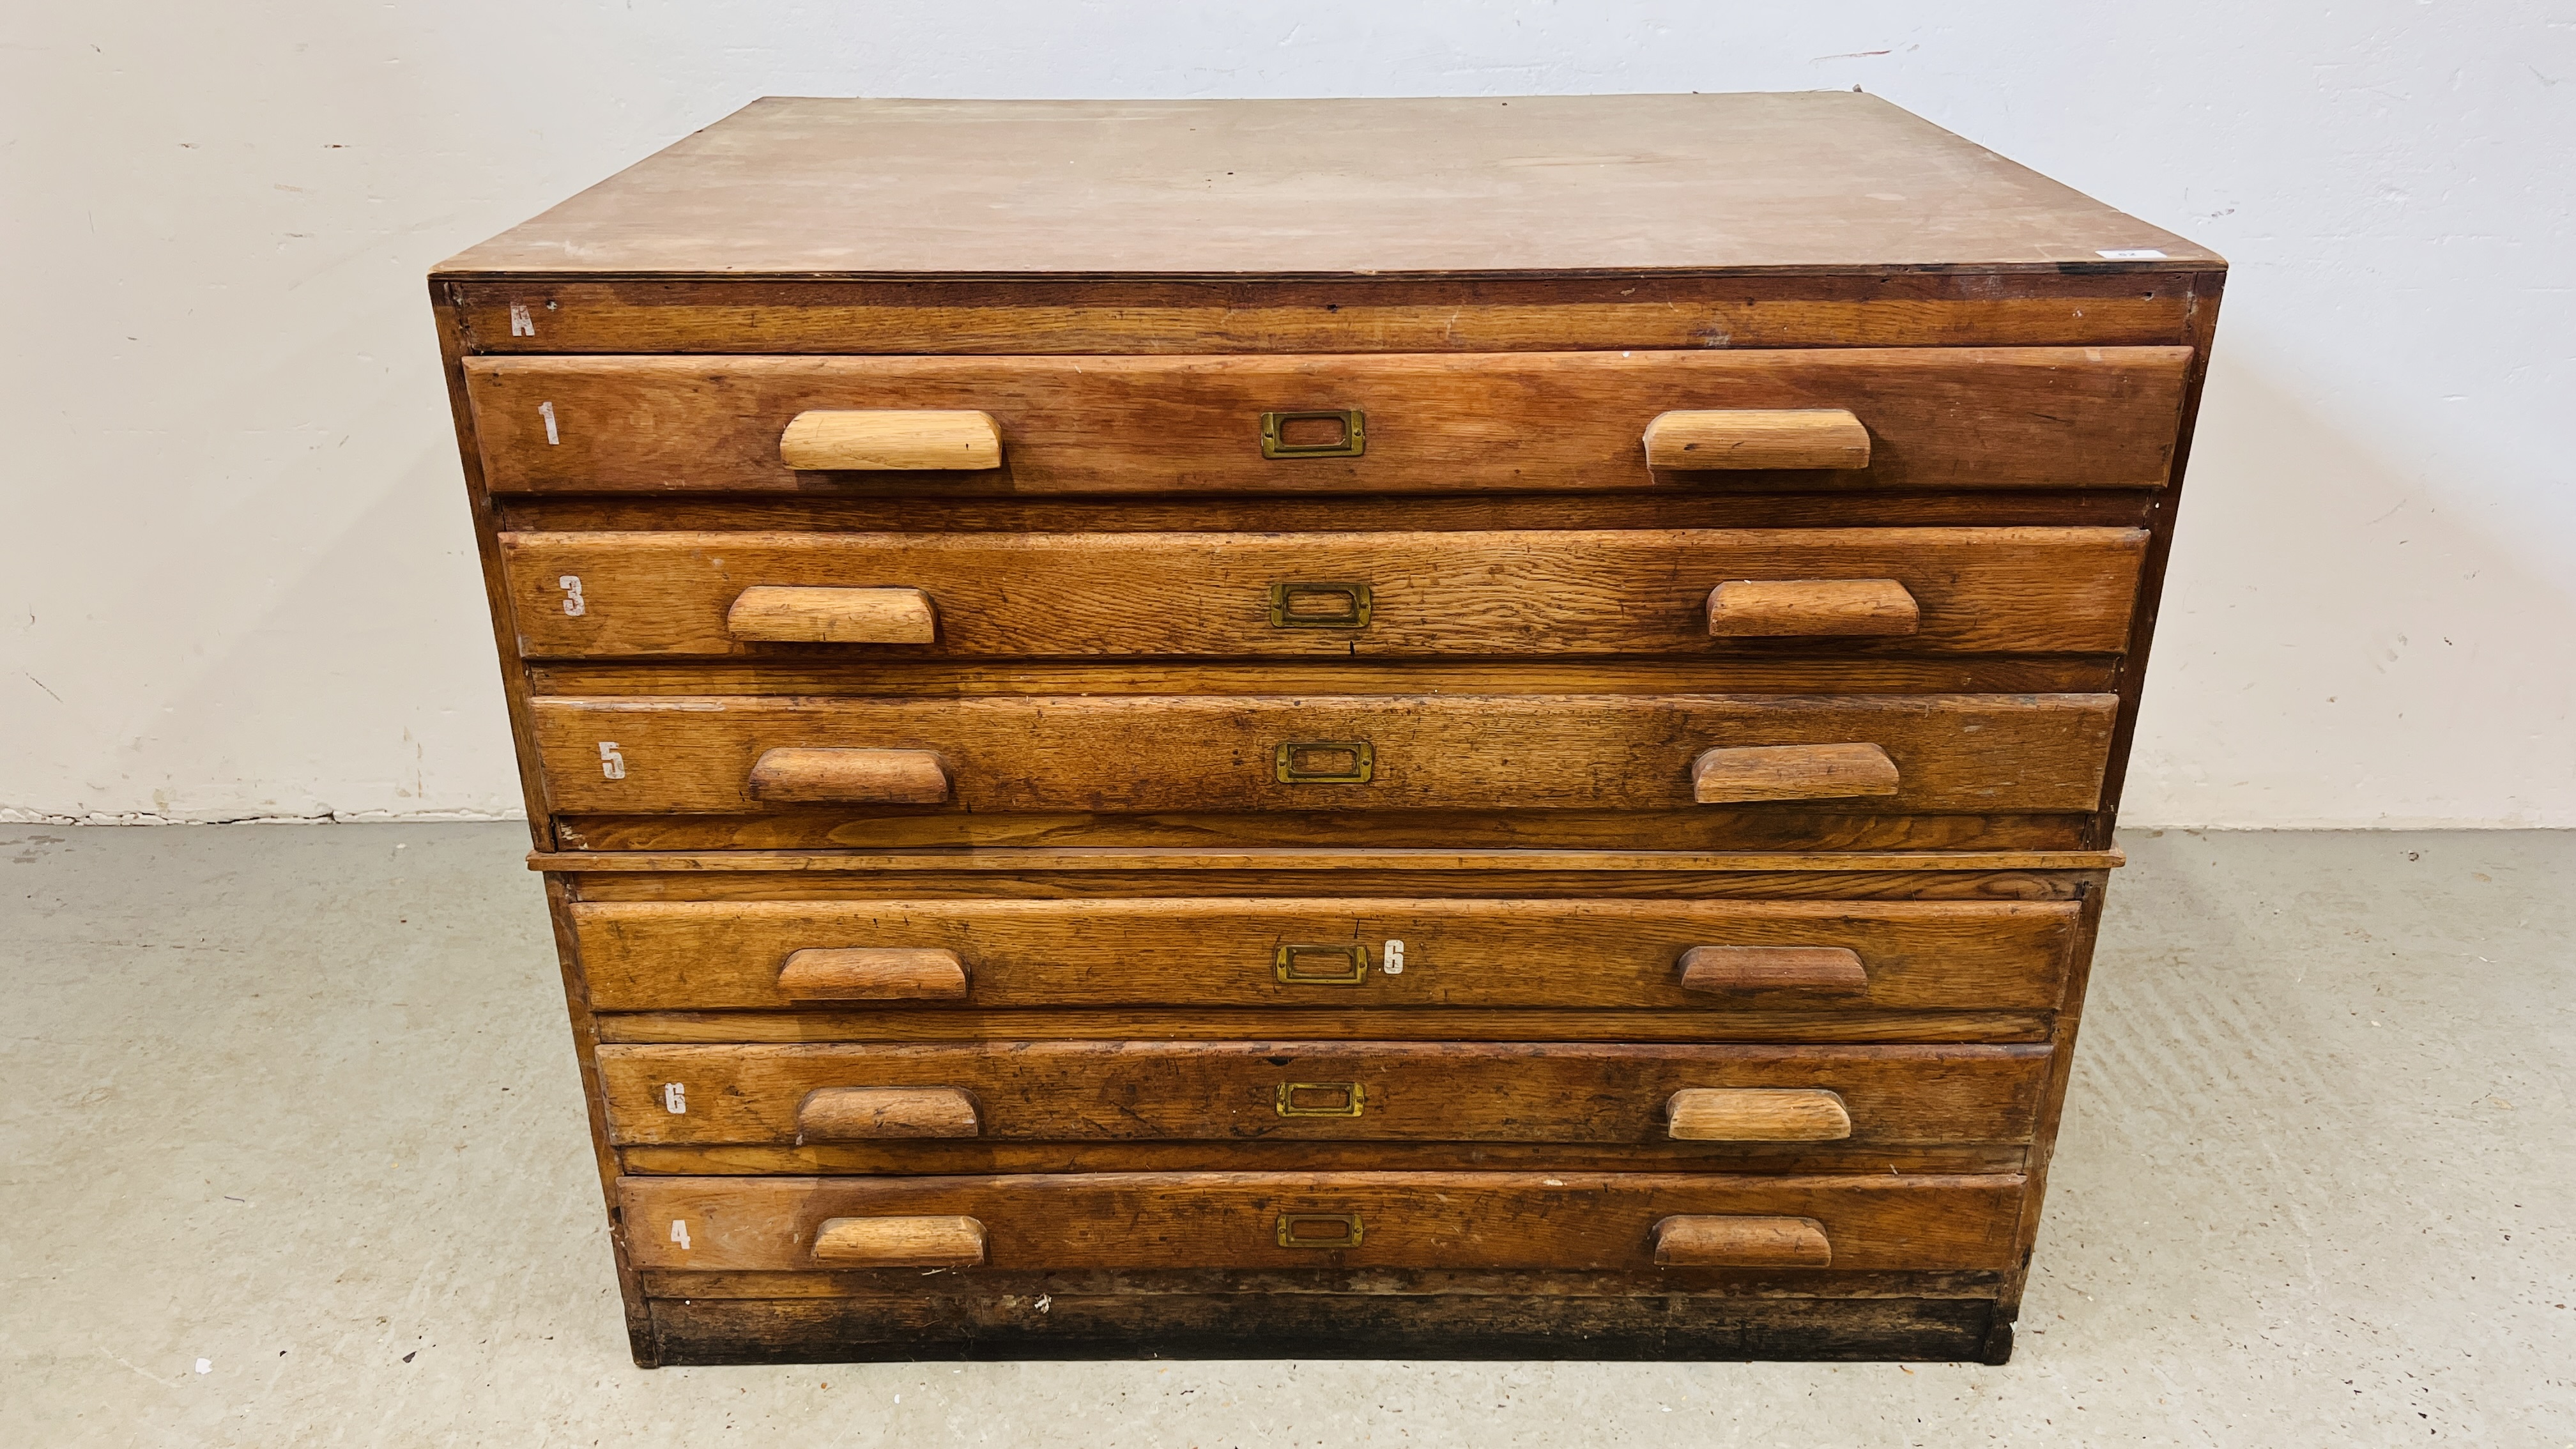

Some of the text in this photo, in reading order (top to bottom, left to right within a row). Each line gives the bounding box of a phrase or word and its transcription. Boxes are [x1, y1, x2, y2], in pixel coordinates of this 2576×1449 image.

[538, 401, 560, 445] 1
[560, 576, 585, 616] 3
[599, 741, 625, 779] 5
[1384, 940, 1404, 974] 6
[664, 1082, 686, 1114] 6
[671, 1220, 691, 1250] 4
